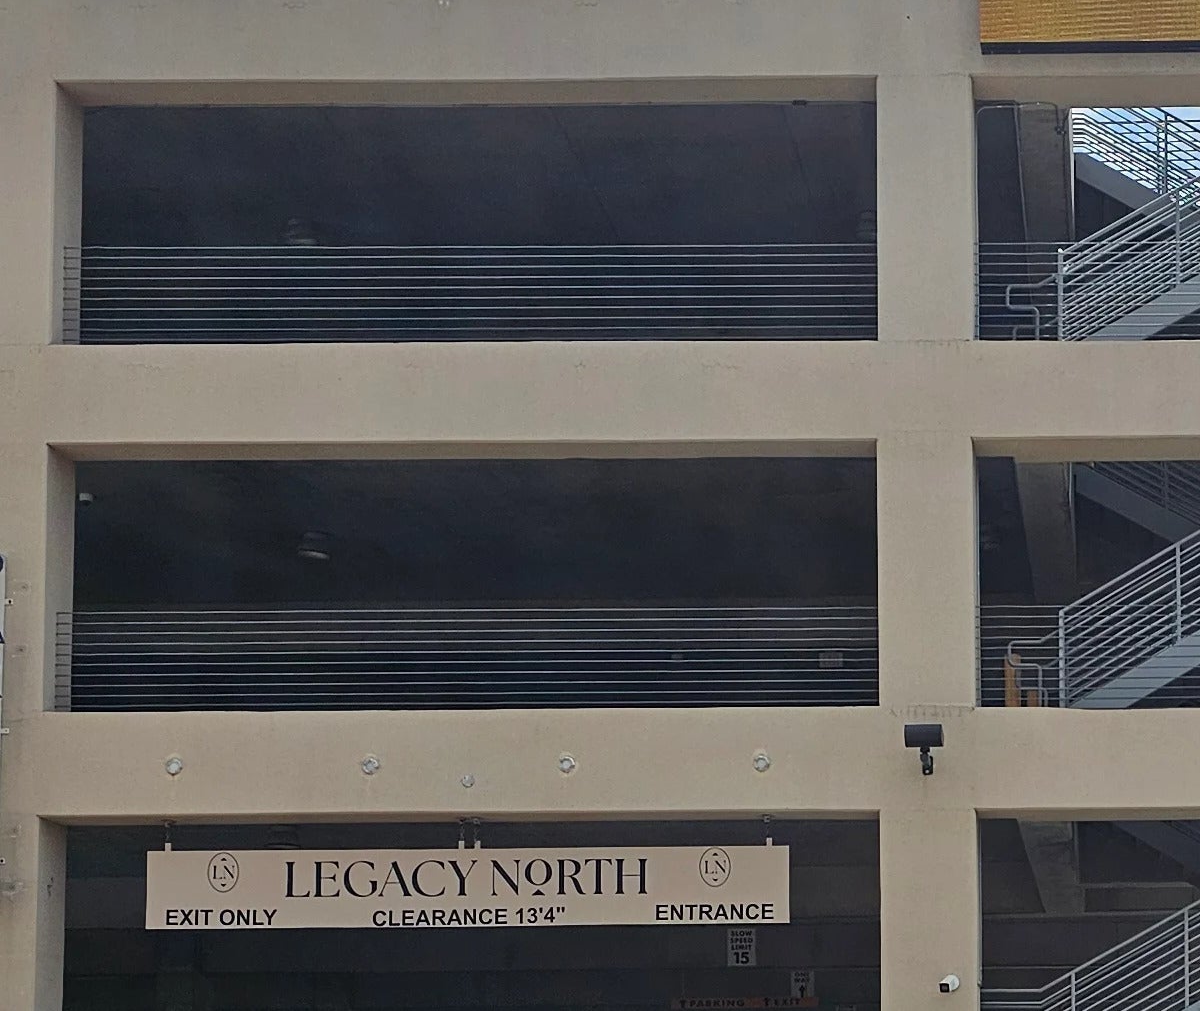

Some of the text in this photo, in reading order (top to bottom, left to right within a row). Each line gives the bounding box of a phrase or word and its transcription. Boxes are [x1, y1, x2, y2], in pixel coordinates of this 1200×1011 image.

[212, 864, 236, 880] LN
[703, 859, 727, 876] LN
[285, 858, 648, 898] LEGACY NORTH
[165, 908, 278, 926] EXIT ONLY
[371, 906, 567, 927] CLEARANCE 13'4"
[655, 903, 775, 921] ENTRANCE
[733, 951, 750, 964] 15
[689, 999, 745, 1007] PARKING
